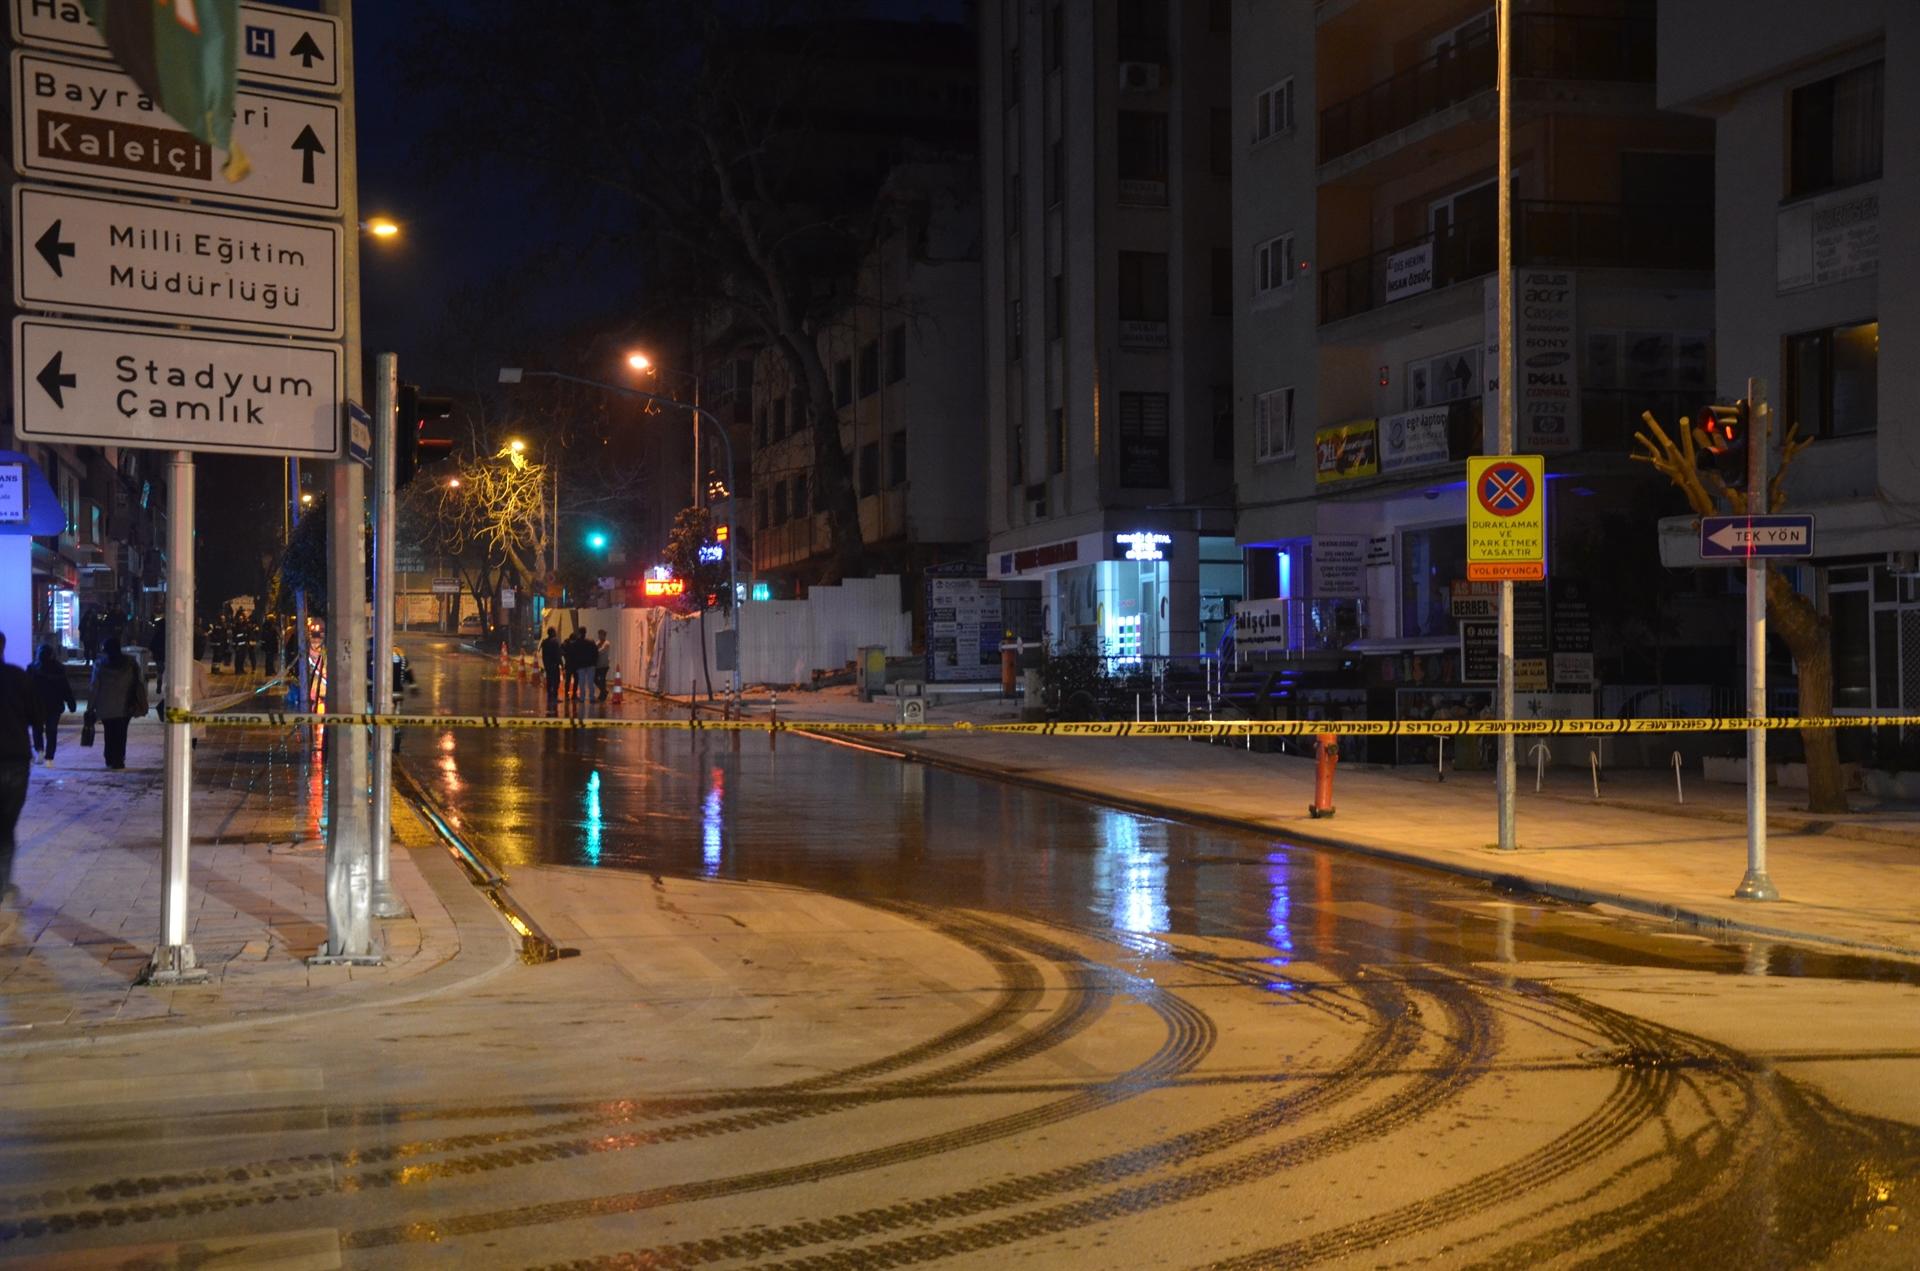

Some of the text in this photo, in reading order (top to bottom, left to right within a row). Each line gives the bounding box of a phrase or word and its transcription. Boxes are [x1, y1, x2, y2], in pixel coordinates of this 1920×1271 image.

[32, 0, 95, 26] Ha
[251, 29, 269, 55] H
[35, 72, 165, 112] Bayra
[47, 120, 201, 172] Kaleiçi
[110, 224, 304, 266] Milli Eğitim
[110, 264, 299, 309] Müdürlüğü
[1526, 273, 1568, 286] ASUS
[1525, 289, 1569, 302] acer
[1526, 338, 1568, 348] SONY
[115, 355, 312, 398] Stadyum
[1527, 372, 1567, 385] DELL
[116, 389, 264, 425] Çamlık
[1473, 521, 1539, 529] DURAKLAMAK
[1500, 530, 1512, 538] VE
[1736, 527, 1800, 542] TEK YÖN
[1472, 539, 1537, 547] PARK ETMEK
[1481, 548, 1532, 556] YASAKTIR
[1474, 567, 1490, 575] YOL
[1454, 600, 1489, 616] BERBER
[1063, 724, 1113, 733] POLİS
[1136, 723, 1214, 733] GİRİLMEZ
[1238, 724, 1286, 733] POLİS
[1309, 723, 1384, 732] GİRİLMEZ
[1406, 723, 1453, 732] POLİS
[1475, 722, 1547, 731] GİRİLMEZ
[1569, 721, 1614, 731] POLİS
[1636, 720, 1707, 730] GİRİLMEZ
